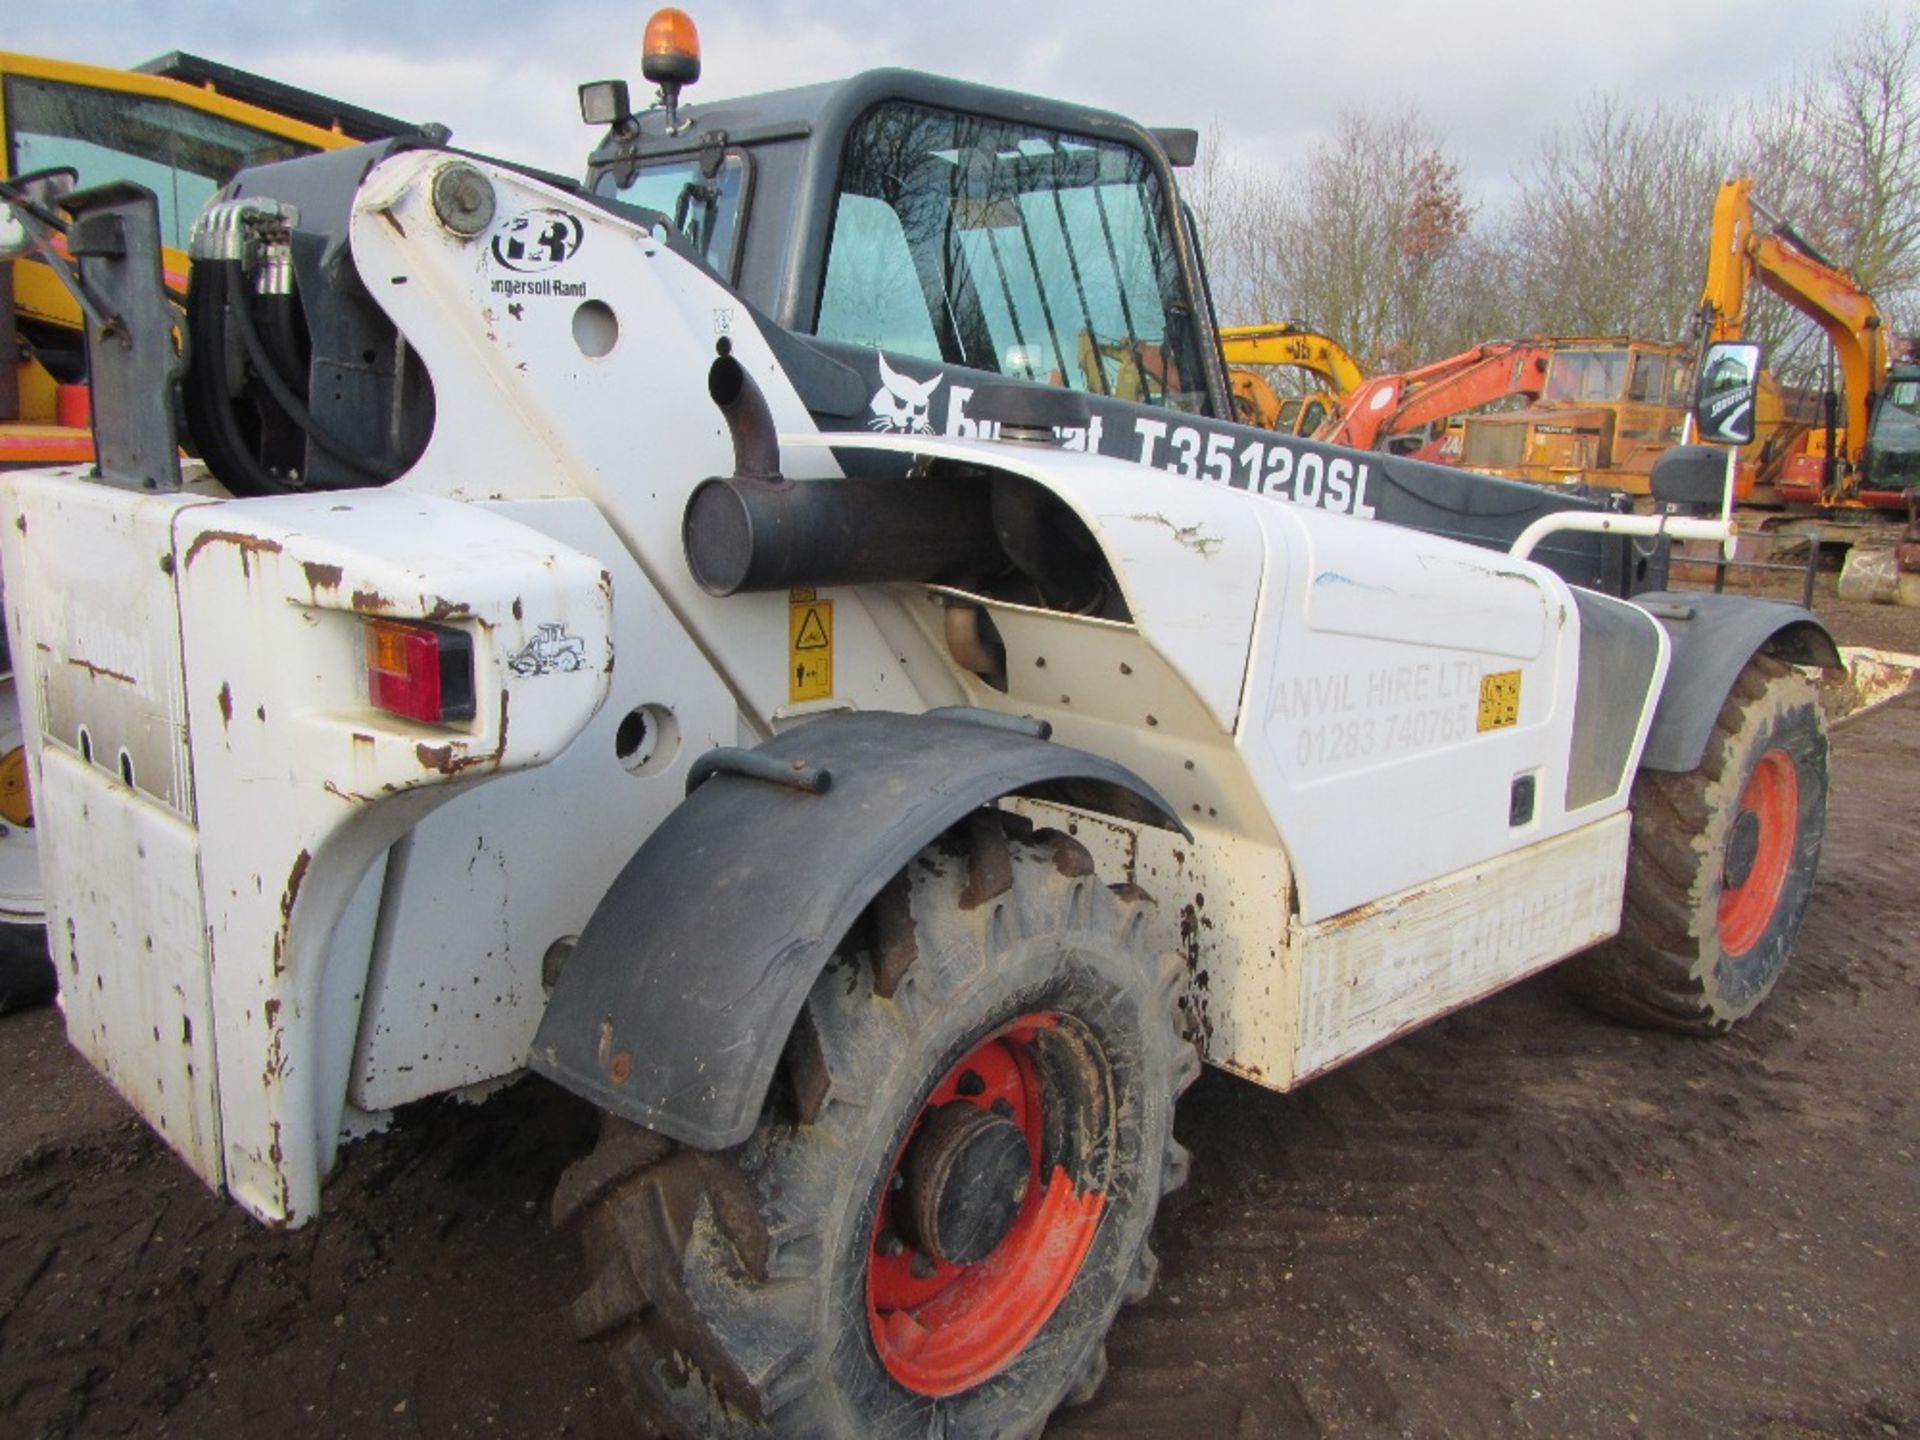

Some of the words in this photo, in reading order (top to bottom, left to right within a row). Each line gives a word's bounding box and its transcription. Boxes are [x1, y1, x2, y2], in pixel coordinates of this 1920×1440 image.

[1267, 673, 1355, 722] ANVIL
[1366, 664, 1432, 708] HIRE
[1295, 717, 1376, 768] 01283
